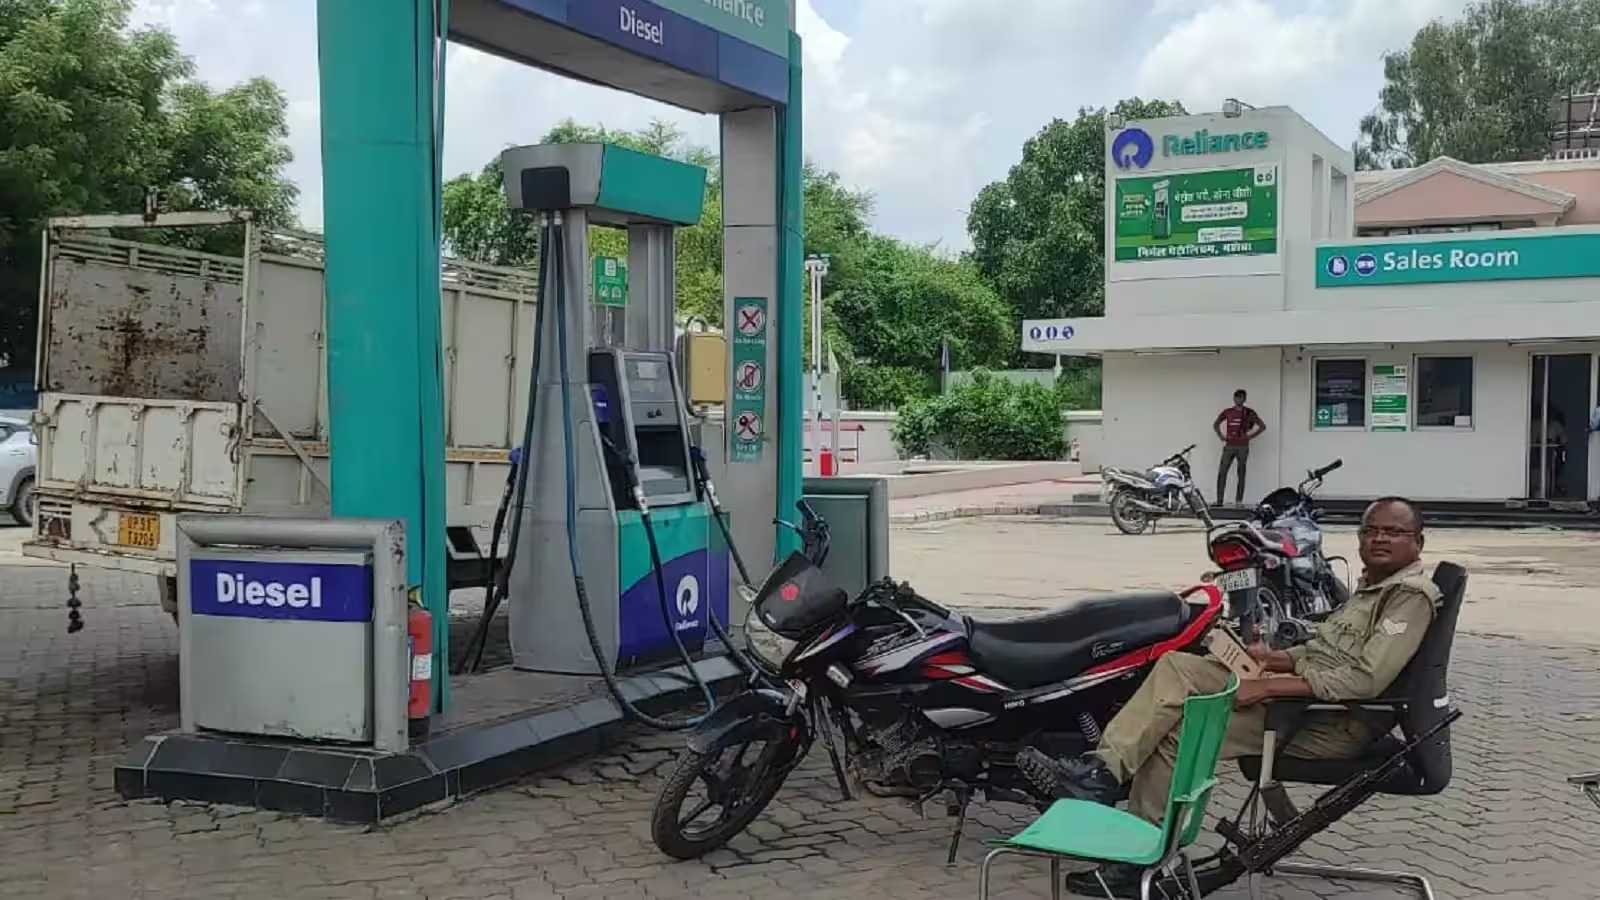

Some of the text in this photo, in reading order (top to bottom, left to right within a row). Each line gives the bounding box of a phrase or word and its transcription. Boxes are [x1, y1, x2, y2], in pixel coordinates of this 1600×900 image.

[620, 6, 664, 45] Diesel
[704, 0, 765, 28] ance
[1162, 128, 1270, 157] Reliance
[1383, 248, 1519, 271] Sales Room
[216, 572, 322, 608] Diesel
